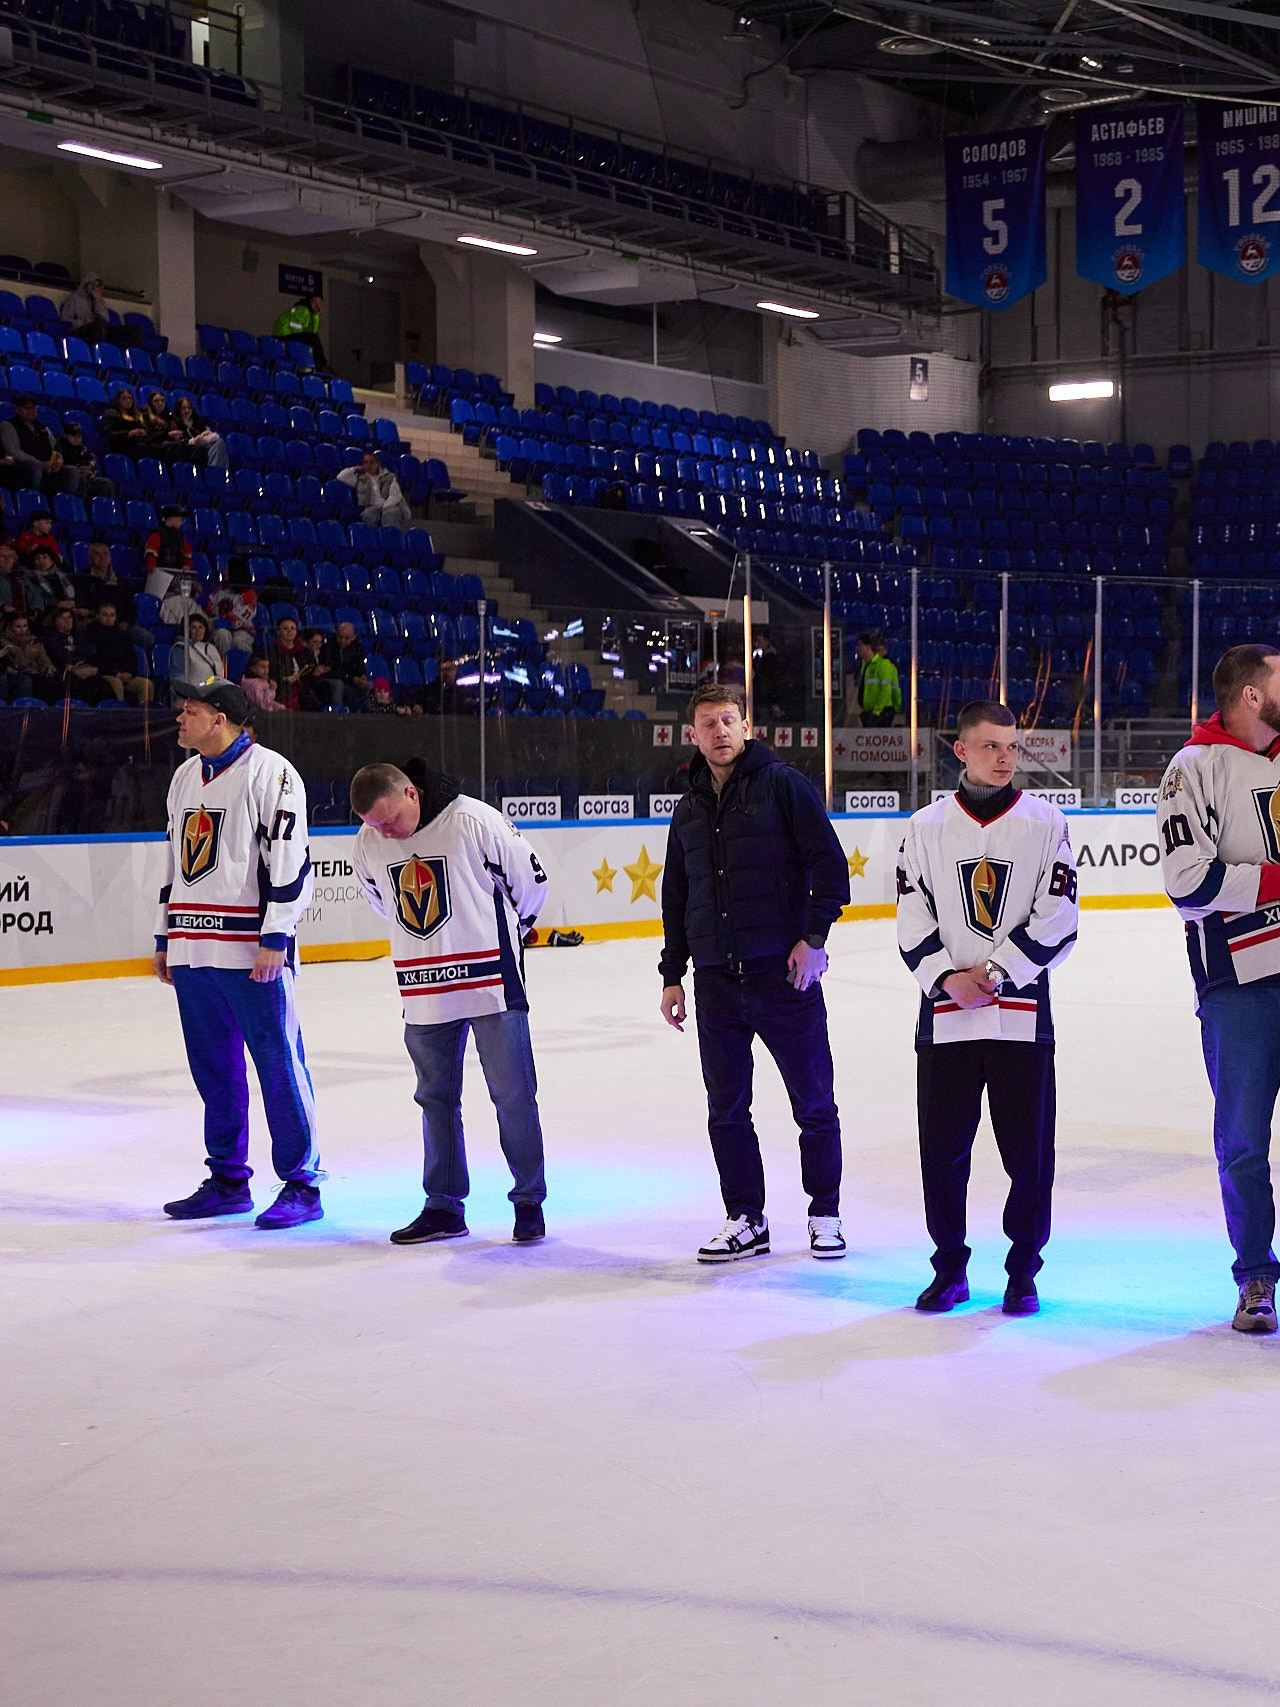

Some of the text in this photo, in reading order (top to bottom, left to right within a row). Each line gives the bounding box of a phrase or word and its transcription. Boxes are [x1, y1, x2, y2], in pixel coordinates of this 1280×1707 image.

[1222, 106, 1278, 129] МИШИН
[1091, 117, 1165, 142] АСТАФЬЕВ
[962, 139, 1026, 164] СОЛОДОВ
[1114, 178, 1143, 237] 2
[982, 199, 1009, 255] 5
[855, 735, 903, 747] СКОРАЯ
[1025, 737, 1055, 748] СКОРАЯ
[850, 750, 908, 763] ПОМОЩЬ
[1021, 752, 1058, 763] ПОМОЩЬ
[1029, 793, 1076, 805] газ
[1161, 813, 1195, 856] 10
[312, 860, 354, 878] ТЕЛЬ
[312, 886, 364, 903] РОДСК
[2, 911, 54, 935] РОД
[403, 966, 469, 984] ХК ЛЕГИОН
